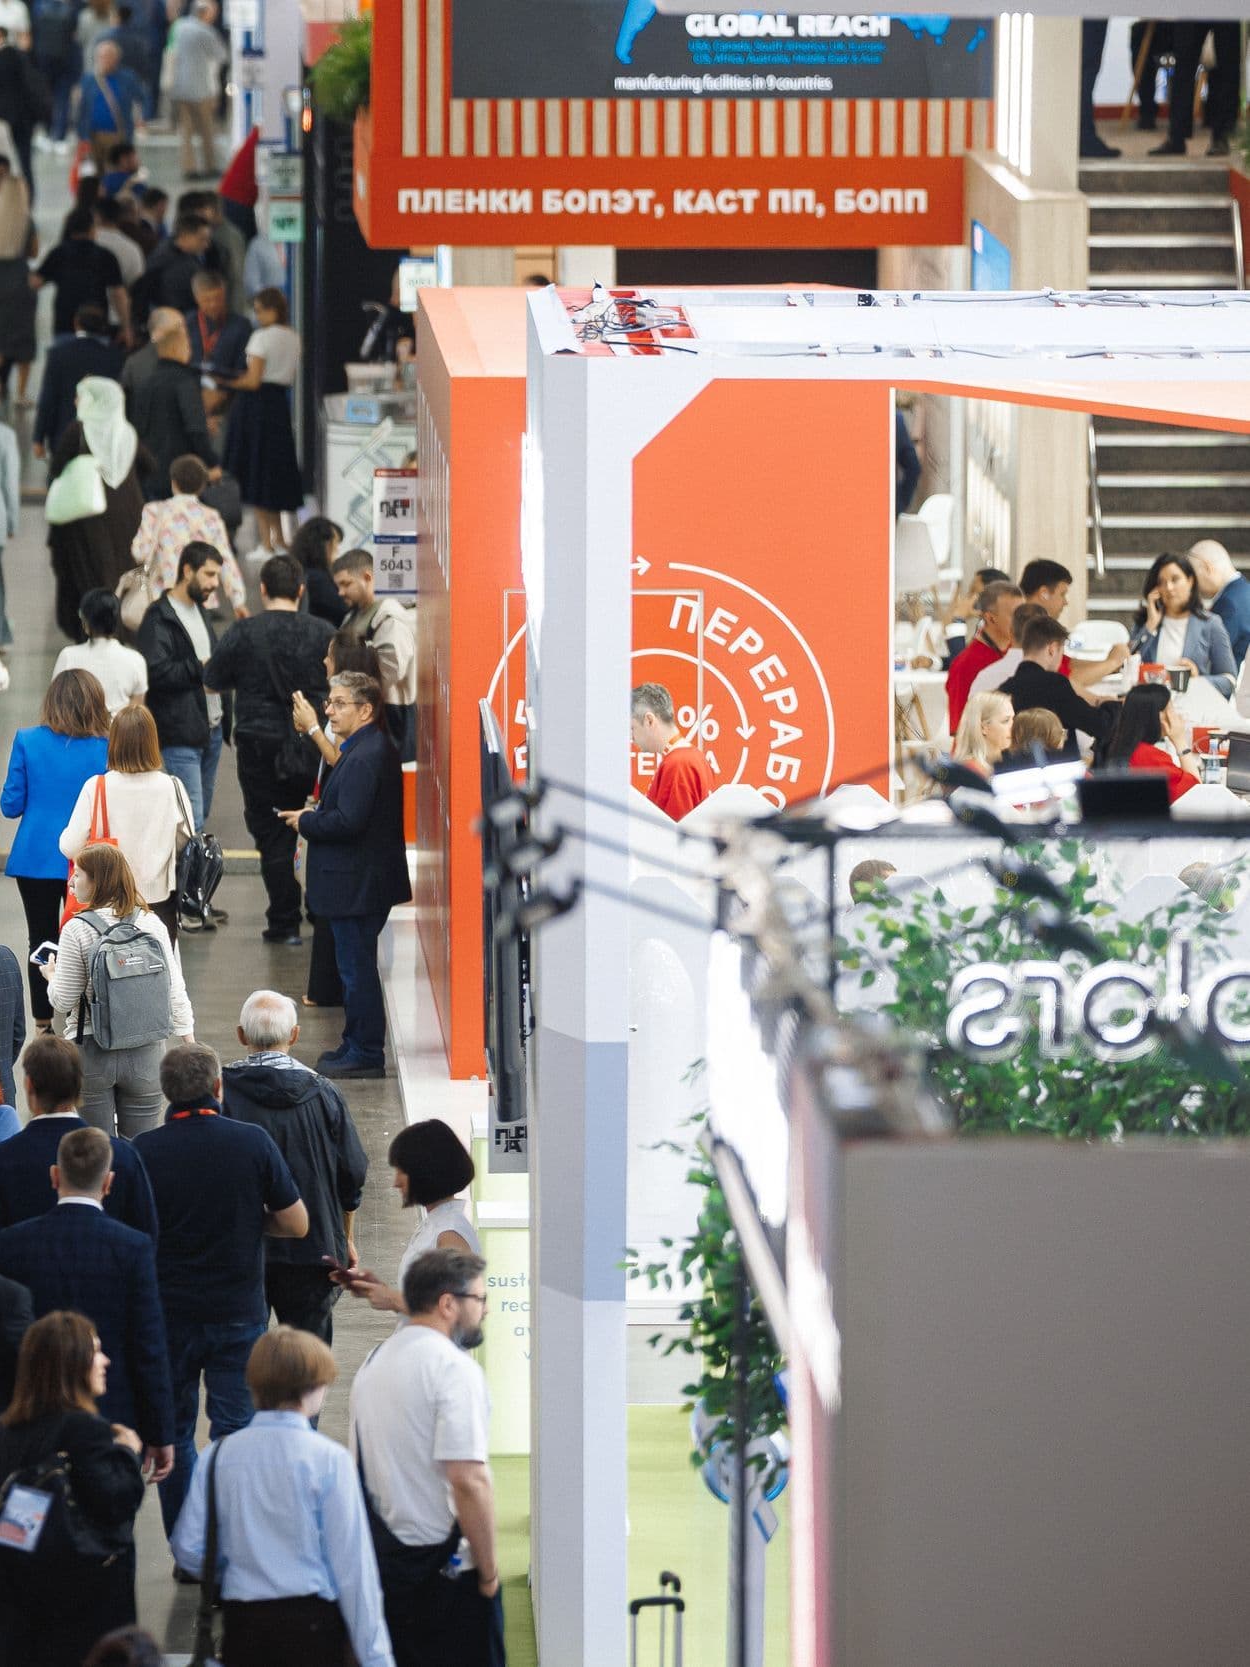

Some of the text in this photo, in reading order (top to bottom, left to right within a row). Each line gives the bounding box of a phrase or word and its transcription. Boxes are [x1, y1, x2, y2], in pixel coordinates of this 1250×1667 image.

[685, 13, 891, 37] GLOBAL REACH
[614, 73, 834, 94] manufacturing facilities in 9 countries
[398, 188, 929, 219] ПЛЕНКИ БОПЭТ, КАСТ ПП, БОПП
[392, 546, 401, 557] F
[380, 559, 413, 571] 5043
[487, 1272, 532, 1288] sust
